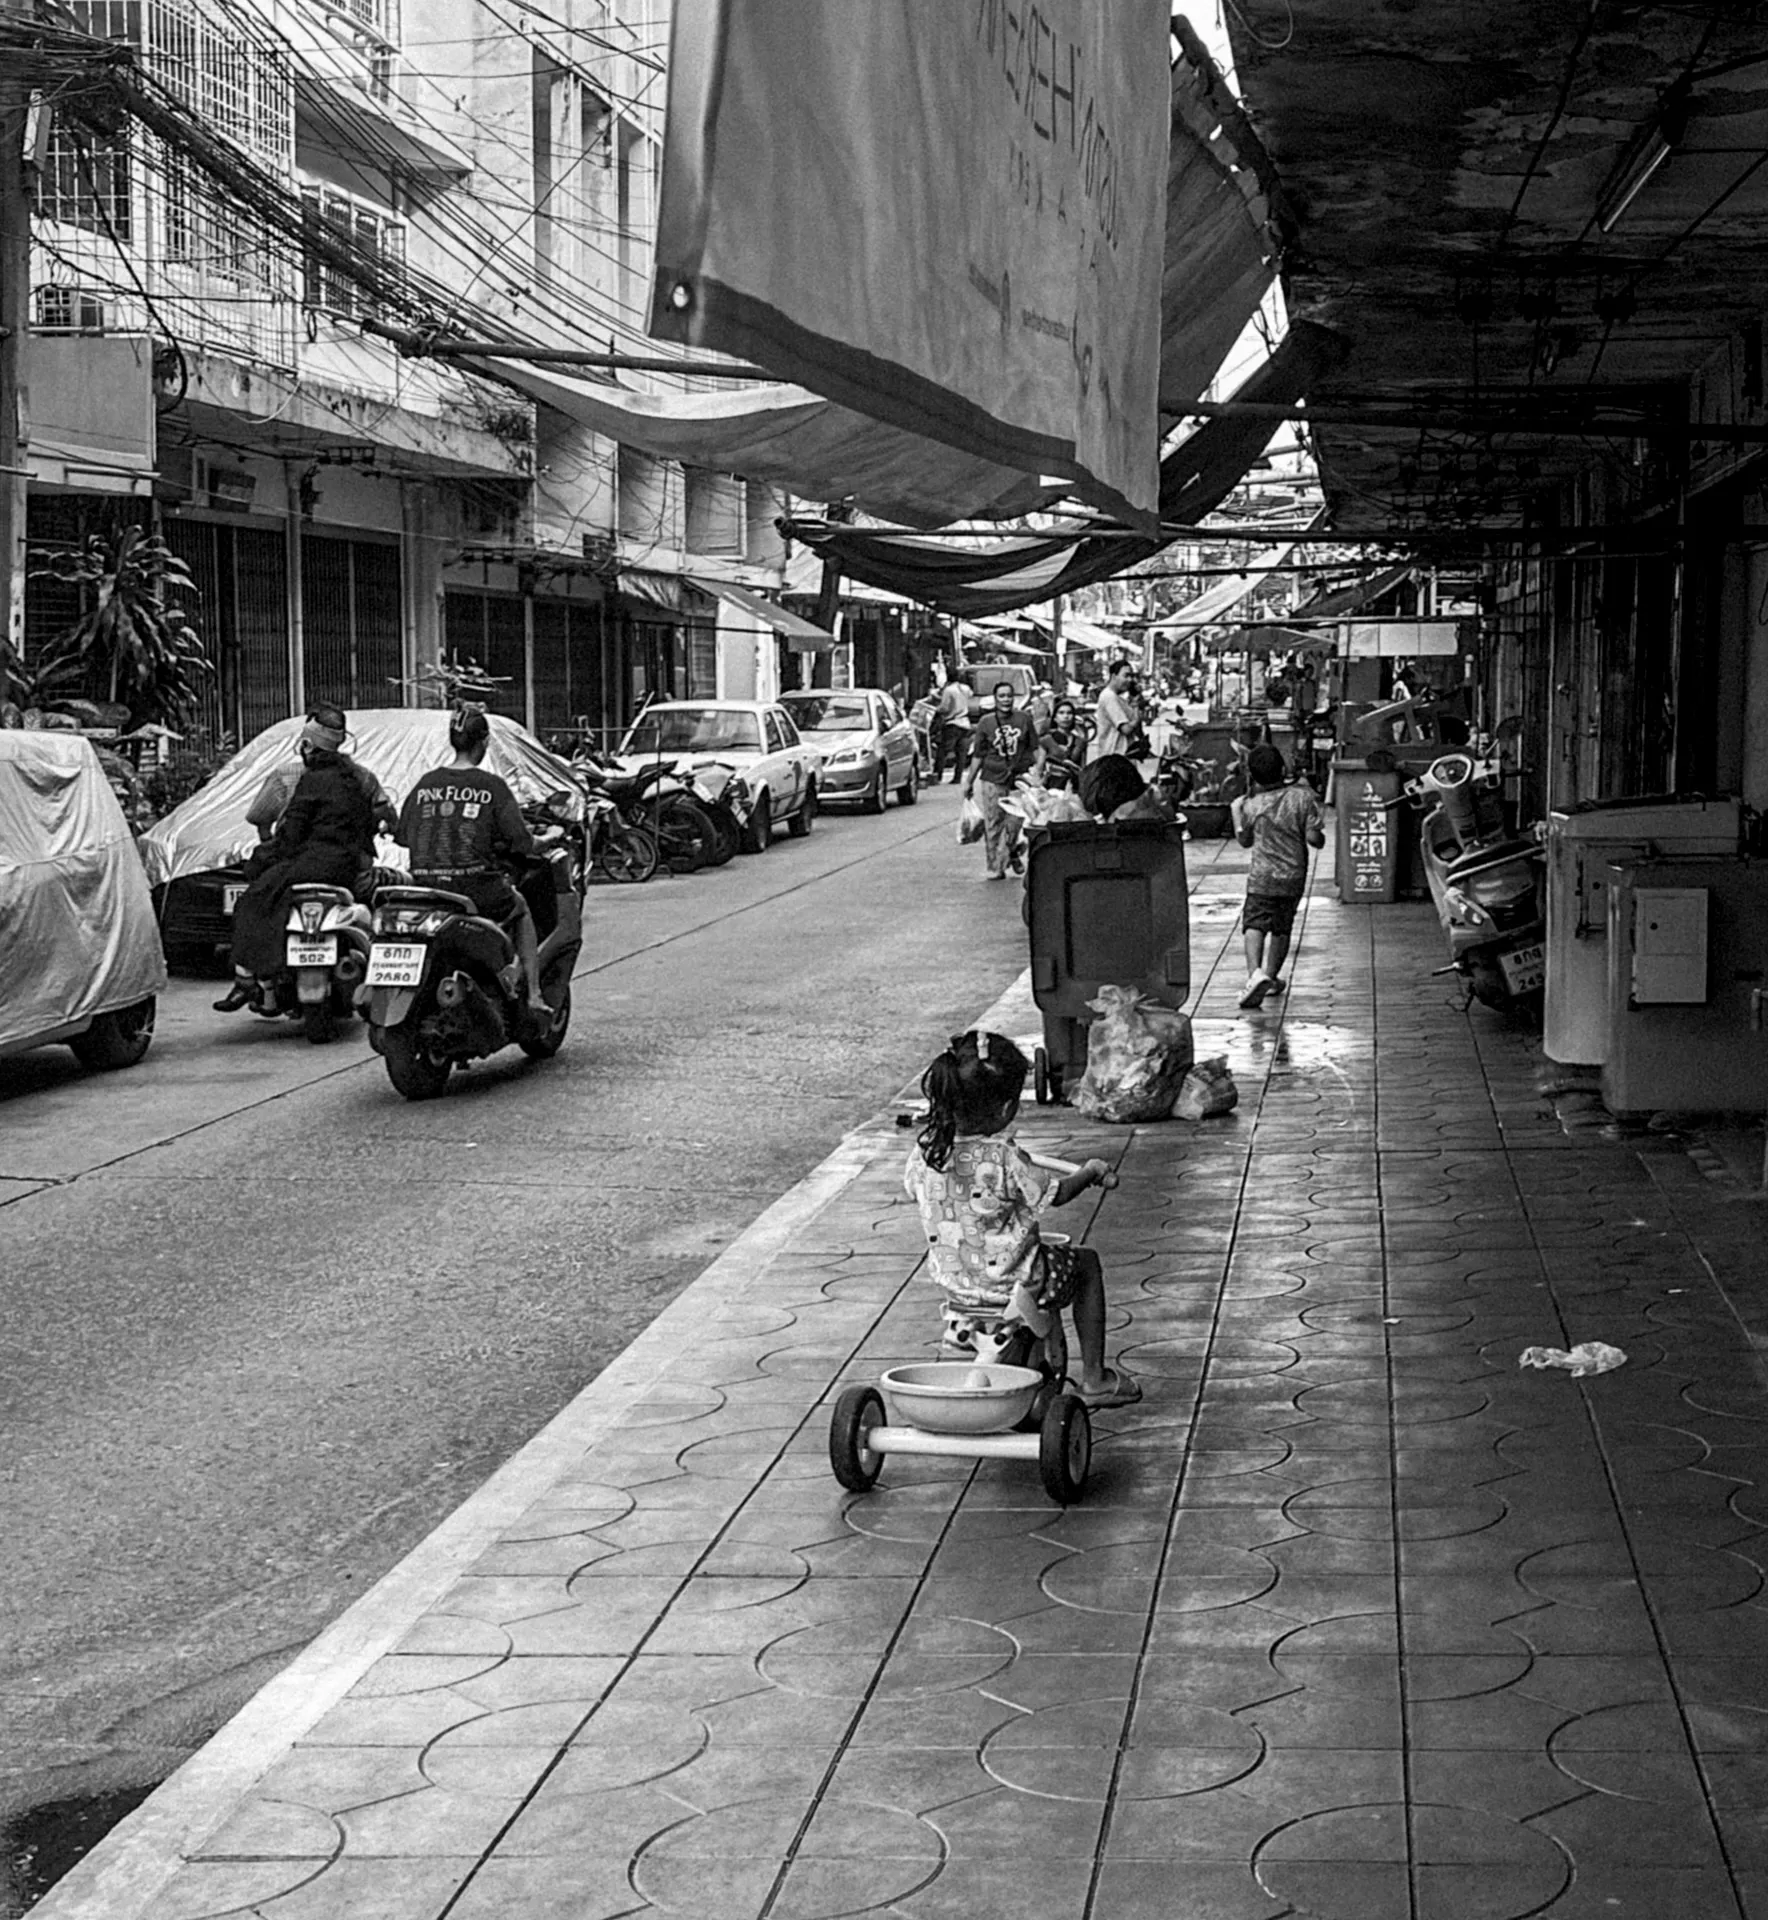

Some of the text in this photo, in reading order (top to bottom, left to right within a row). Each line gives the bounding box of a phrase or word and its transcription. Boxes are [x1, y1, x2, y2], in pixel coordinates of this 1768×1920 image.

[445, 785, 492, 804] FLOYD
[299, 953, 325, 963] 502
[375, 972, 411, 983] 2680
